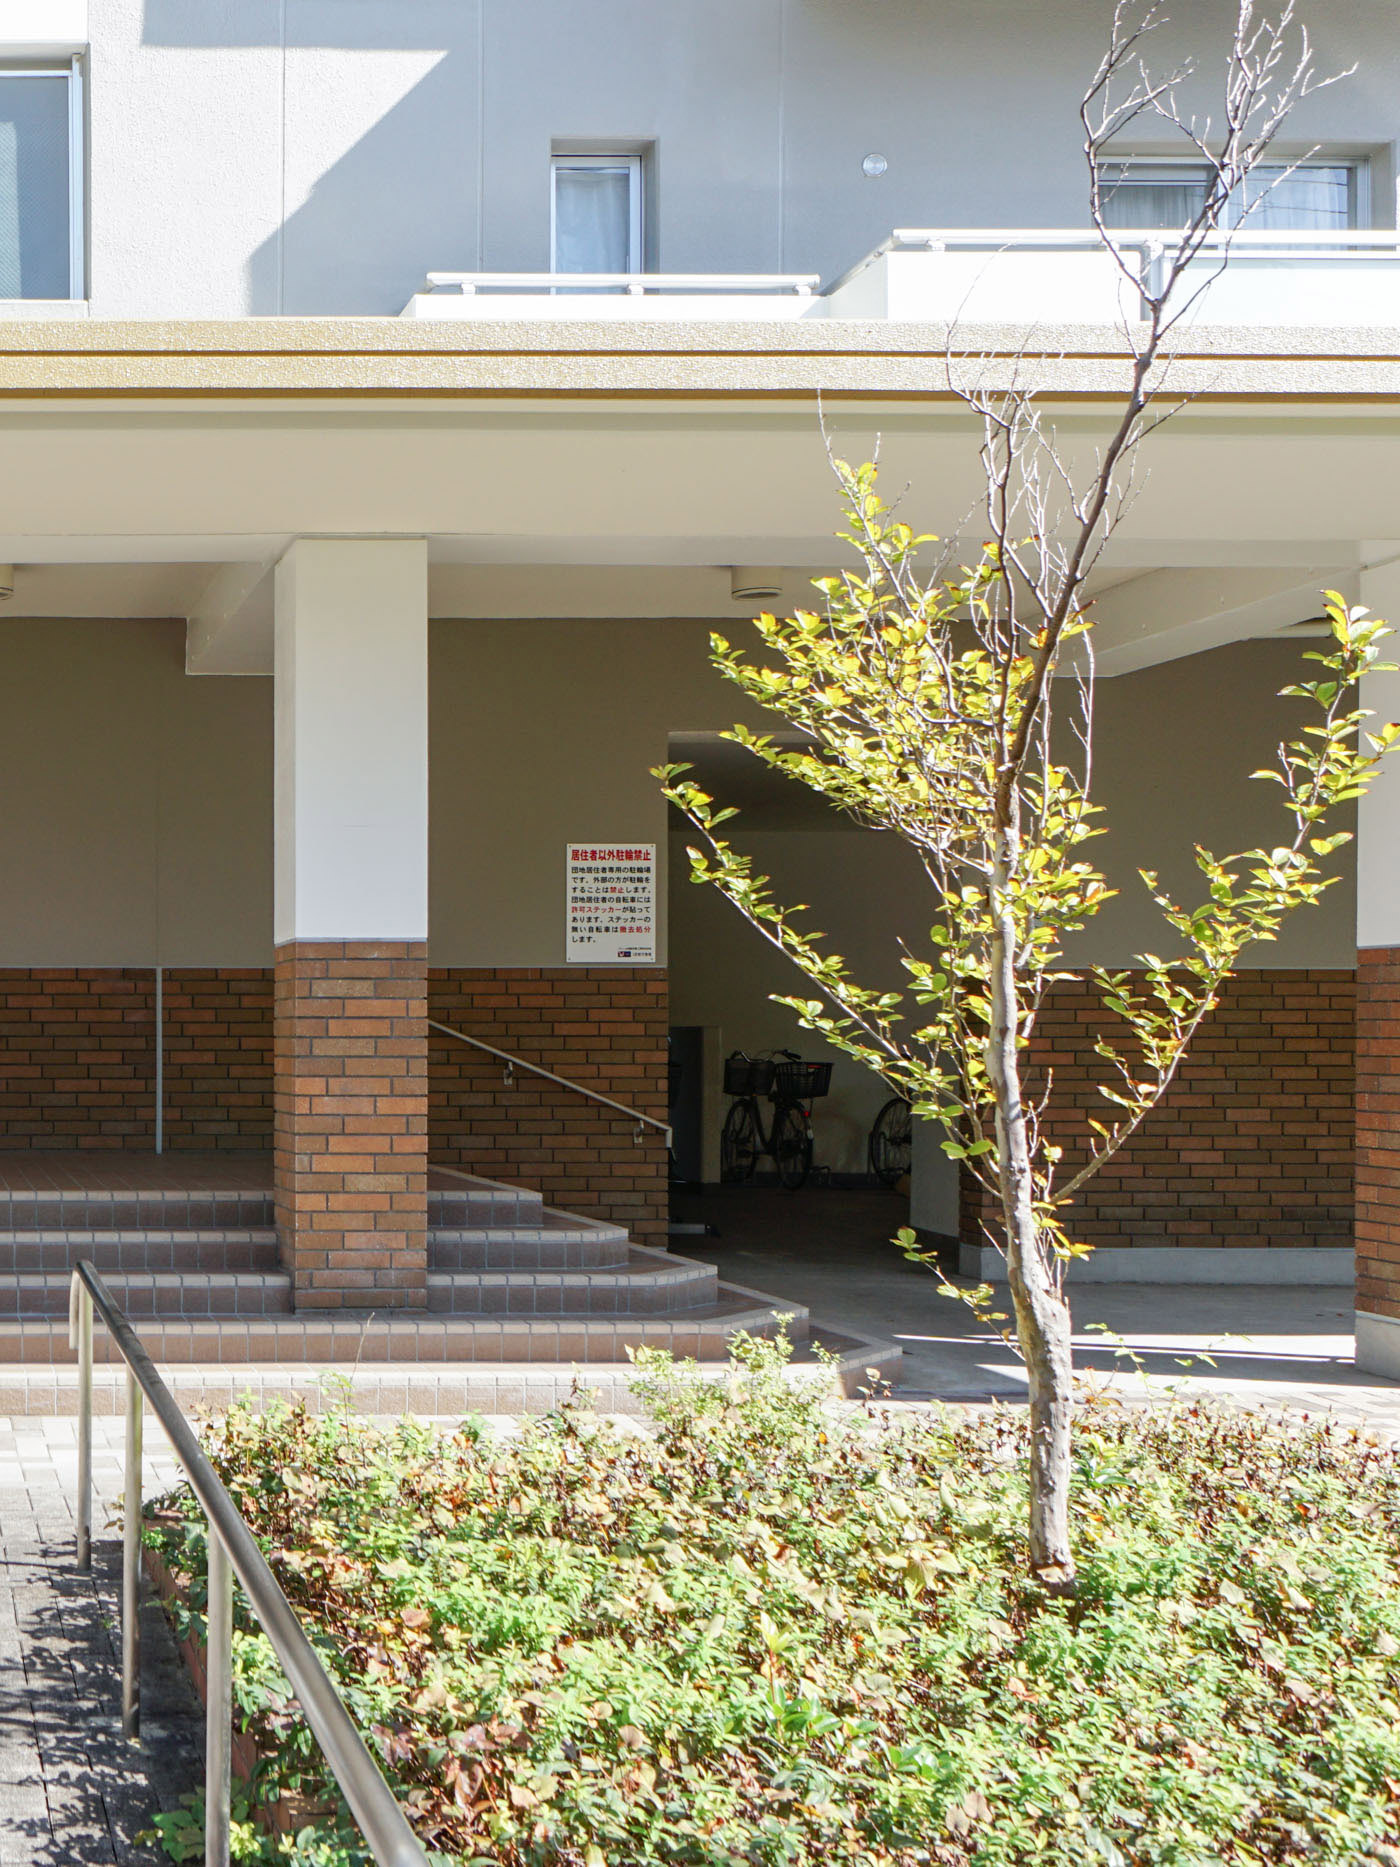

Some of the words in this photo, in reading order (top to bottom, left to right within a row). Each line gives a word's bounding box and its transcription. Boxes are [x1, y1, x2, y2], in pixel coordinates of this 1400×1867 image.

[571, 849, 652, 861] 居住者以外駐輪禁止
[571, 886, 651, 894] することは禁止します。
[571, 896, 651, 904] 団地居住者の自転車には
